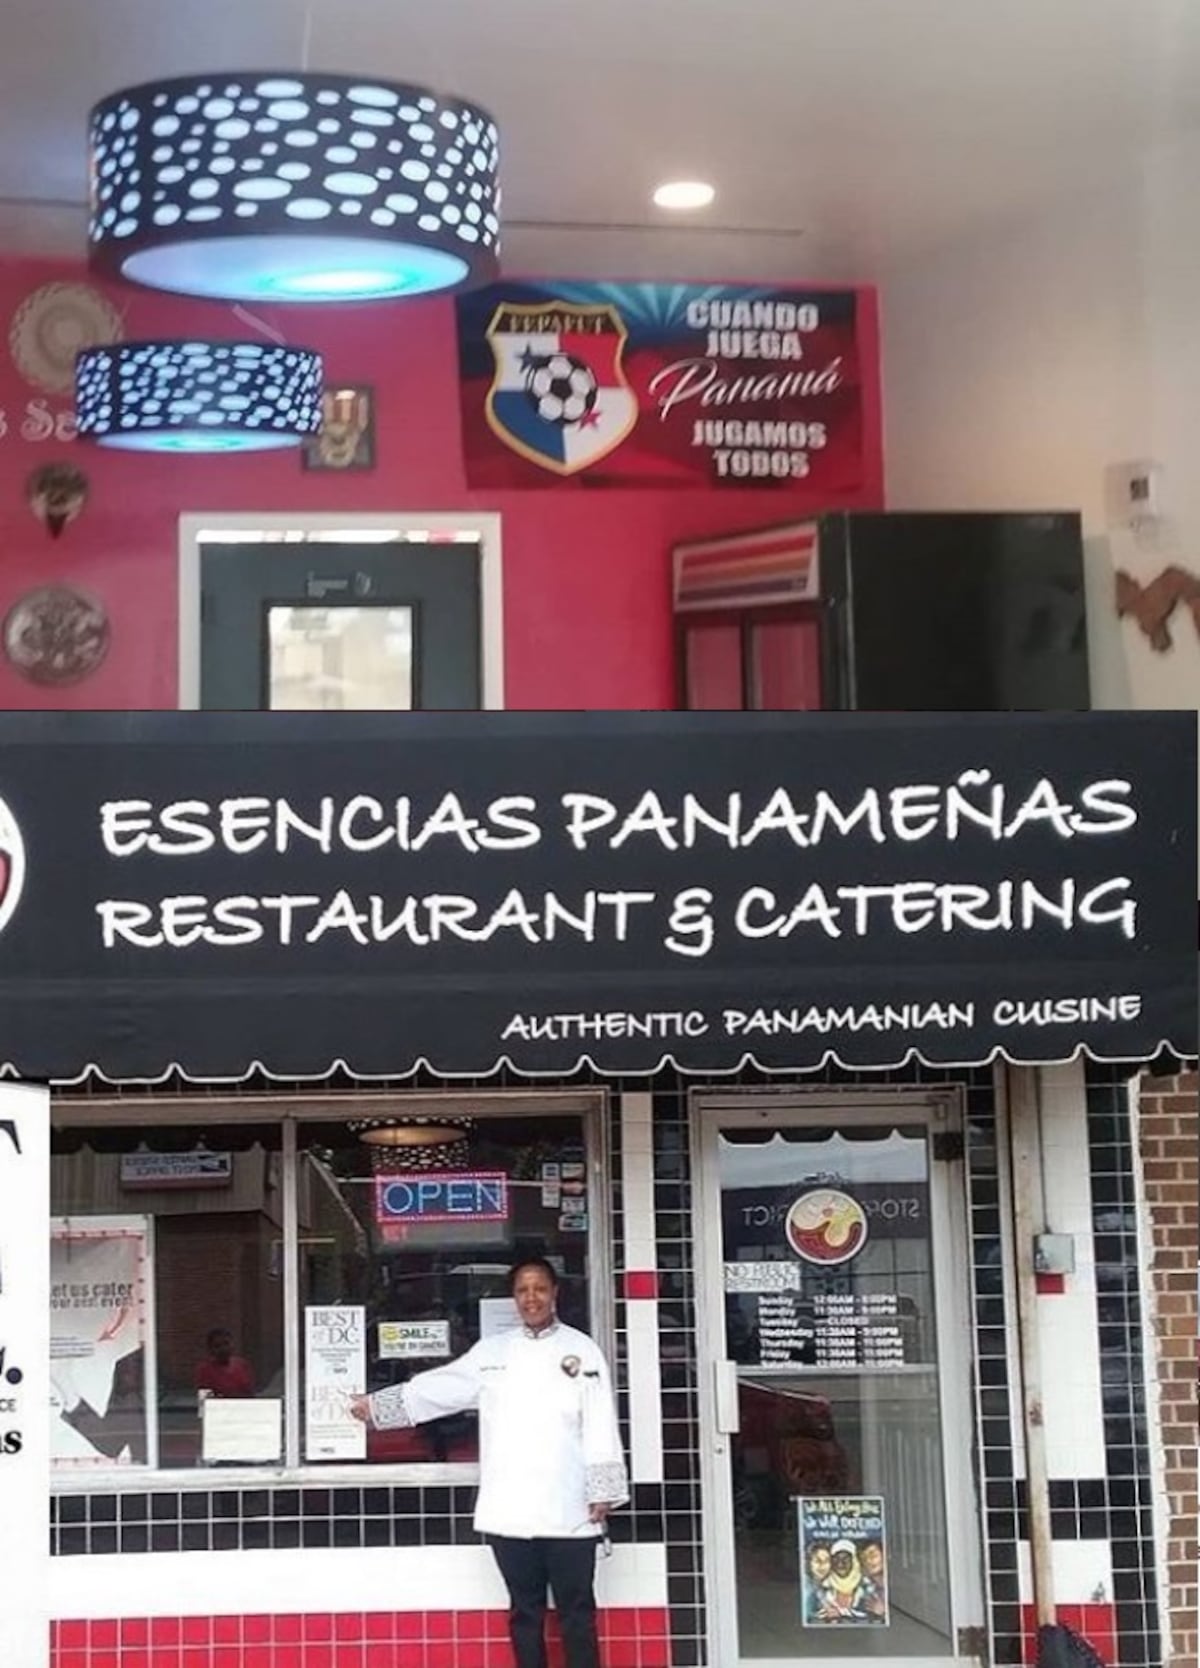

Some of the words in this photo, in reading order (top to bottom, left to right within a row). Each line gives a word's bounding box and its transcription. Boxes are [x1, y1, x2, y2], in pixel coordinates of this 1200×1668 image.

[686, 299, 818, 332] CUANDO
[706, 330, 802, 360] JUEGA
[649, 356, 842, 422] Panamá
[692, 420, 827, 449] JUGAMOS
[713, 449, 810, 478] TODOS
[100, 792, 541, 856] ESENCIAS
[562, 769, 1137, 851] PANAMEÑAS
[96, 889, 655, 948] RESTAURANT
[665, 888, 715, 957] &
[736, 876, 1137, 939] CATERING
[500, 1011, 709, 1040] AUTHENTIC
[723, 1002, 974, 1035] PANAMANIAN
[993, 995, 1141, 1026] CUISINE
[383, 1180, 501, 1214] OPEN
[93, 1282, 132, 1298] cater
[312, 1311, 361, 1326] BEST
